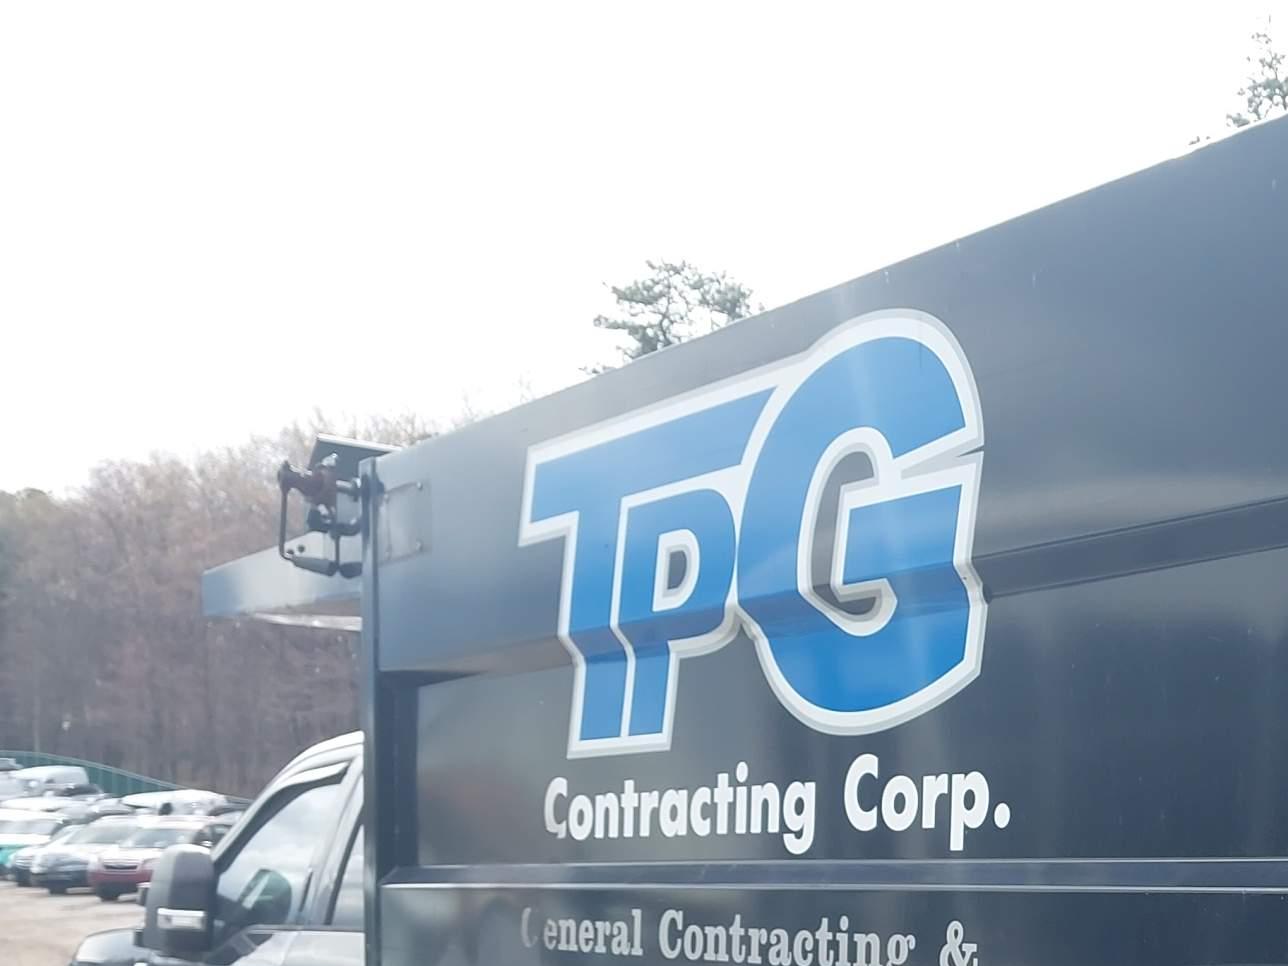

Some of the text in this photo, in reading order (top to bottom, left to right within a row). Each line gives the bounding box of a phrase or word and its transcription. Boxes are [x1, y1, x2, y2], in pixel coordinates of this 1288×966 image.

[518, 308, 988, 759] TPG
[544, 753, 1011, 854] Contracting Corp.
